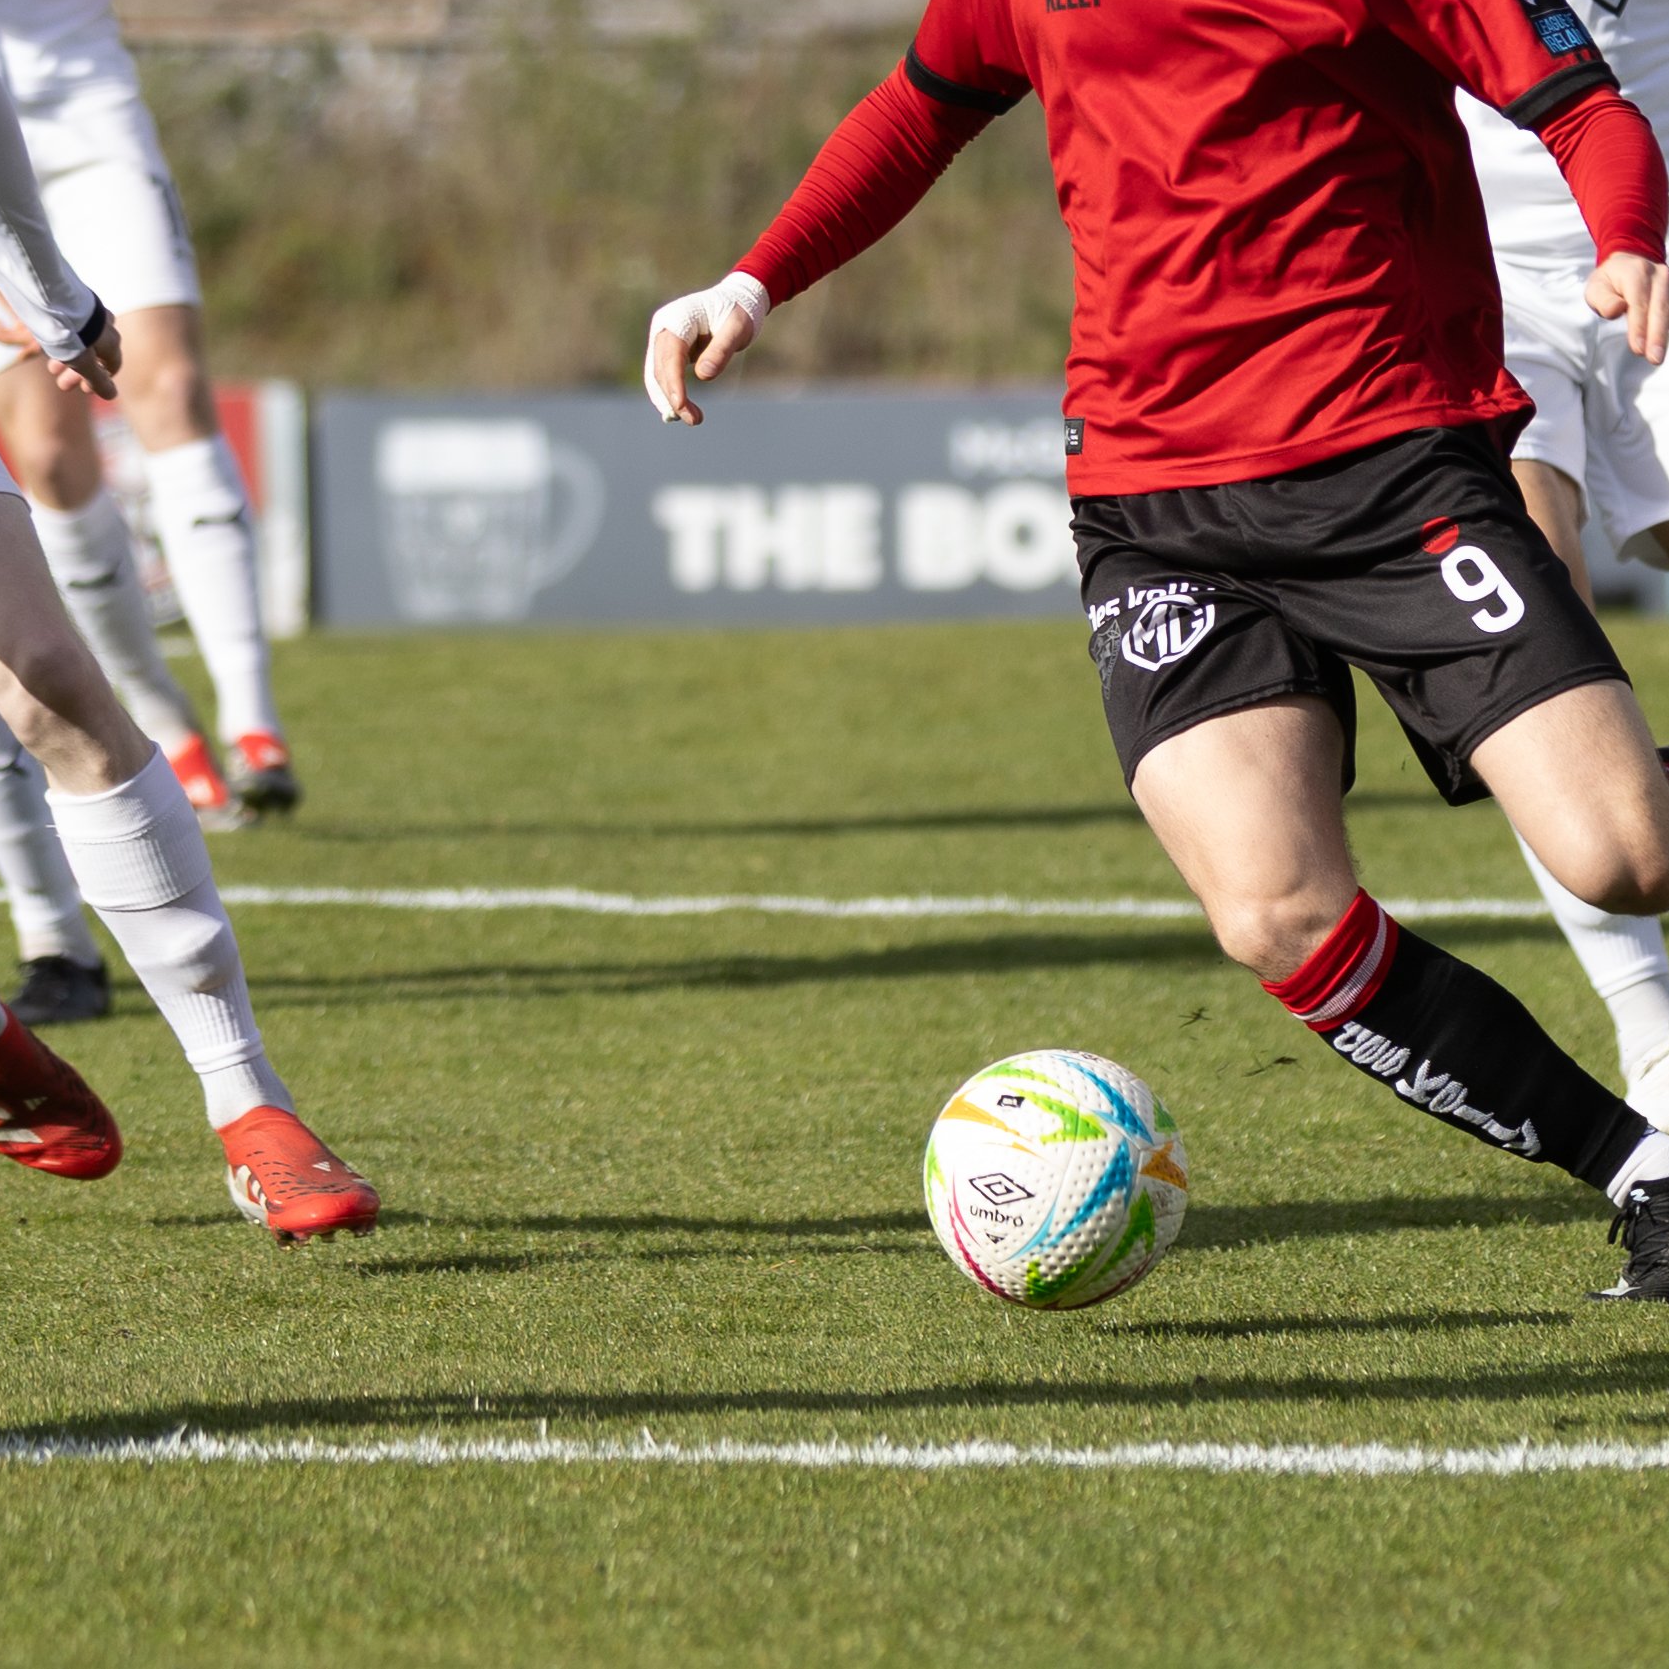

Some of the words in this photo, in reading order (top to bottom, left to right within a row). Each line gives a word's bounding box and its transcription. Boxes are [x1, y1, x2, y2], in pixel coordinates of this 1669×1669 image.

[652, 484, 883, 593] THE
[897, 482, 1082, 592] BO
[1440, 545, 1525, 633] 9
[969, 1204, 1024, 1227] umbro
